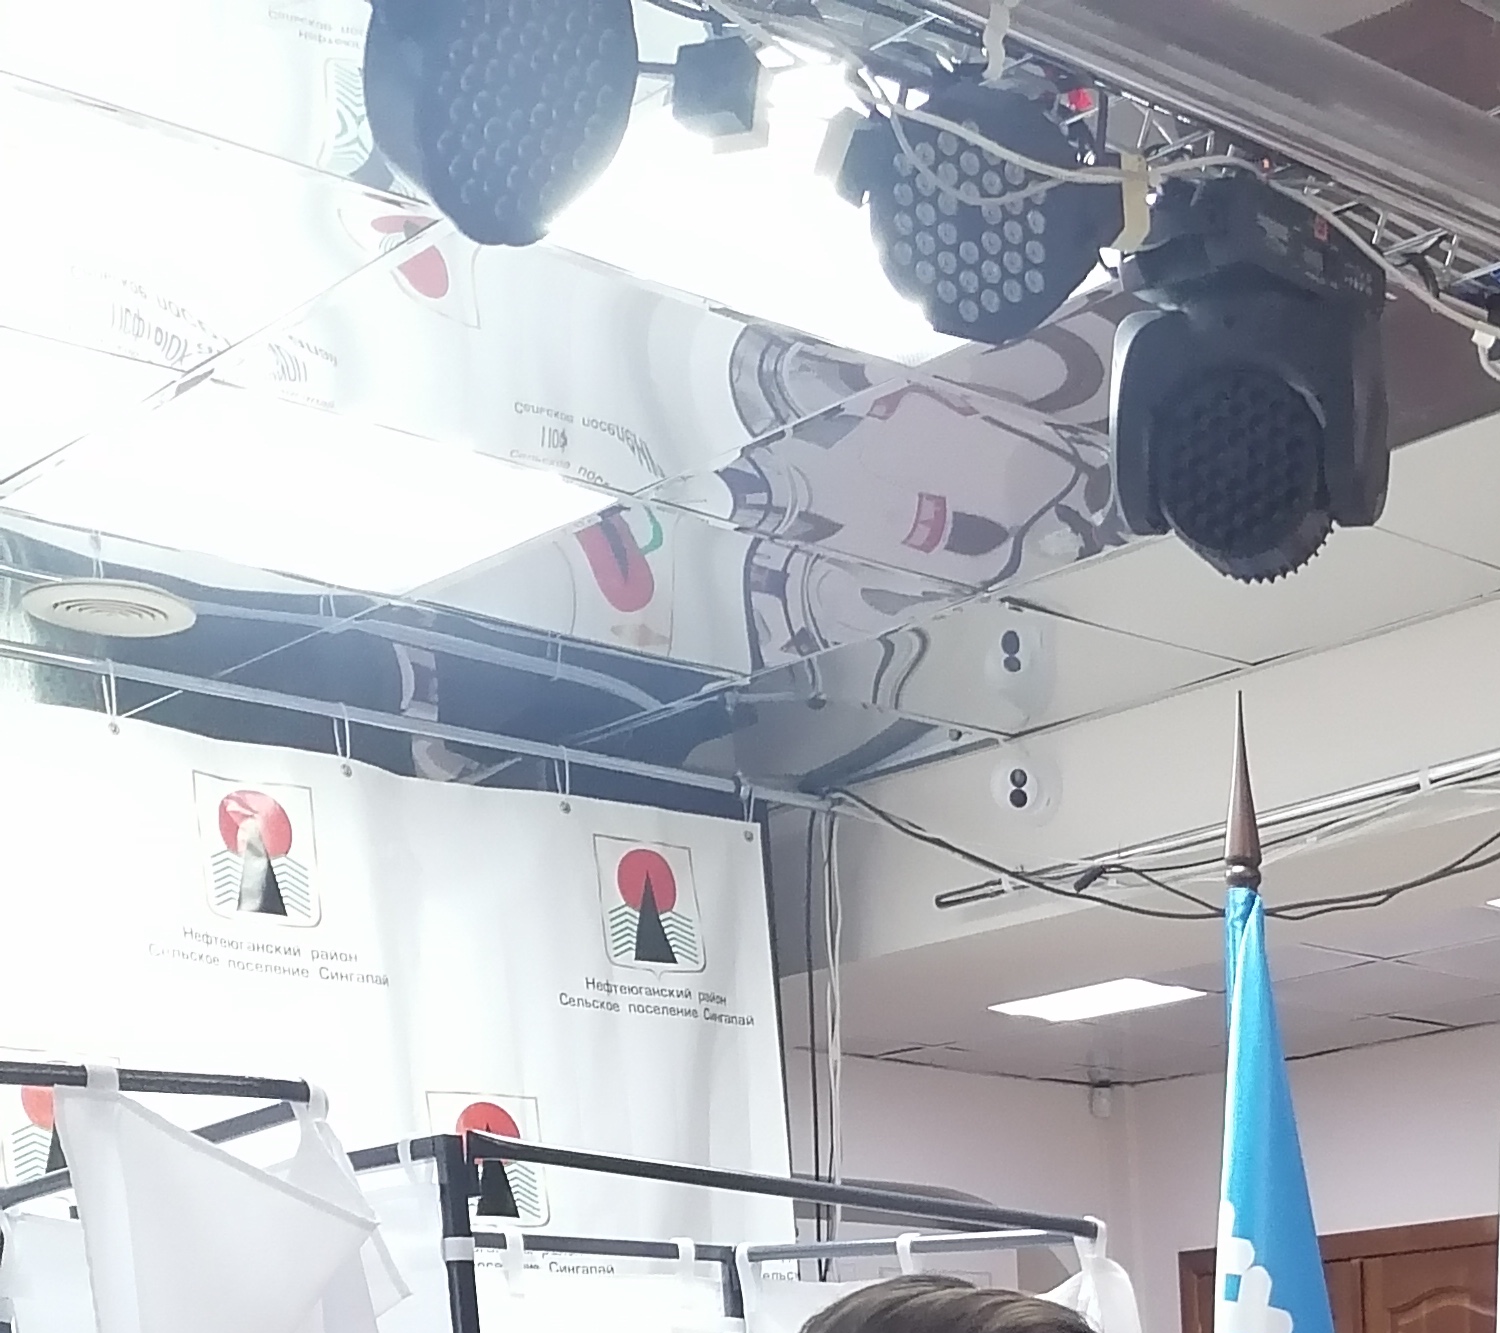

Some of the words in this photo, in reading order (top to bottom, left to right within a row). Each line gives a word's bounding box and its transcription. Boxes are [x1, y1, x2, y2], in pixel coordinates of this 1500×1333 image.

[183, 926, 301, 957] Нефтеюганский
[310, 949, 358, 963] район
[228, 958, 310, 978] поселение
[319, 966, 390, 987] Сингапай
[585, 977, 692, 1000] Нефтеюганский
[697, 991, 727, 1006] район
[559, 993, 621, 1013] Сельское
[628, 1003, 699, 1019] поселение
[703, 1007, 754, 1026] Сингапай
[548, 1260, 615, 1275] Сингапай
